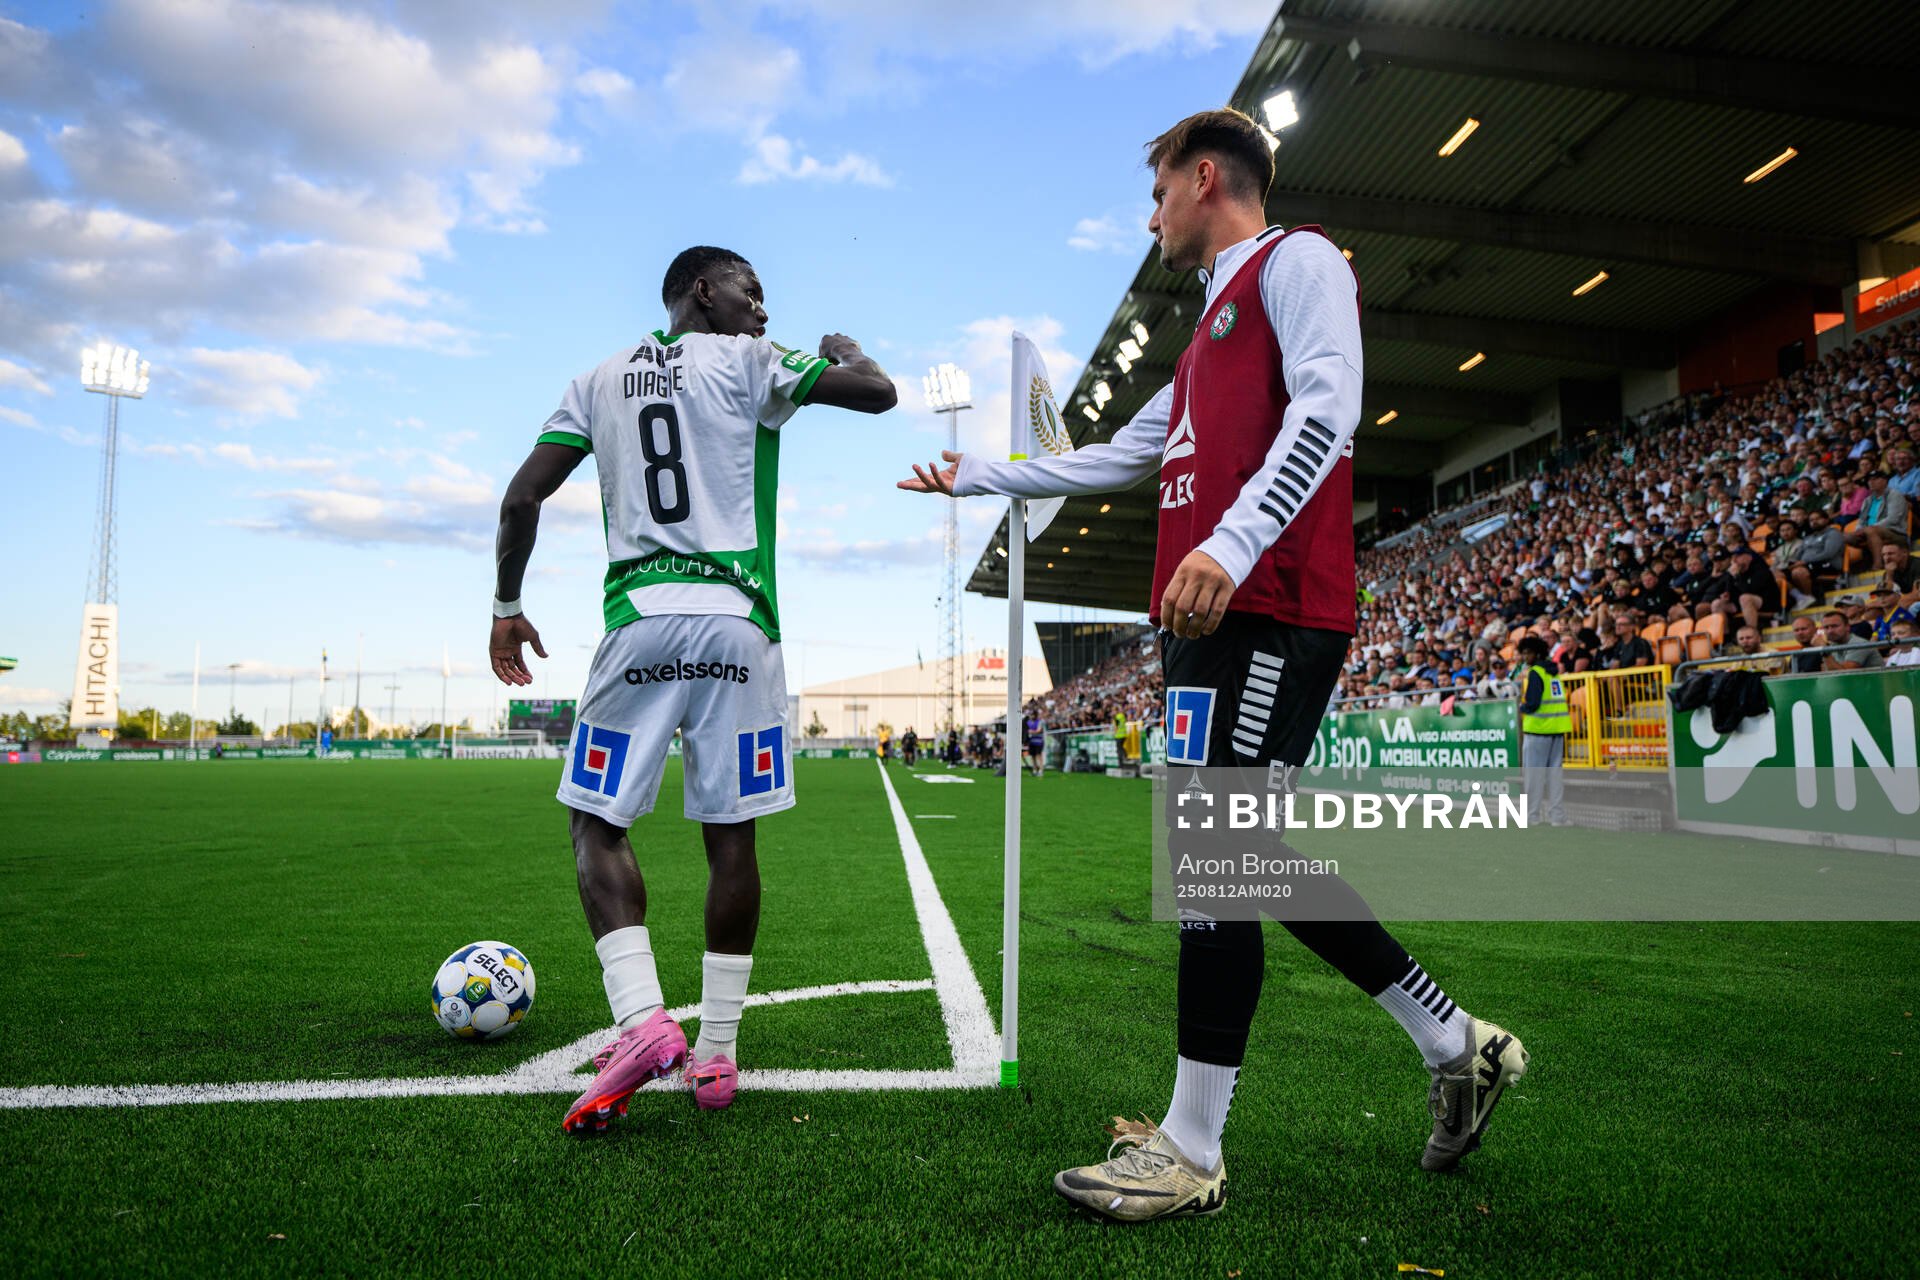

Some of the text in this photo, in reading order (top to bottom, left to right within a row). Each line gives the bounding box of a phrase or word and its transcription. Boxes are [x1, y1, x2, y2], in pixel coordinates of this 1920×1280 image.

[1875, 280, 1920, 312] Swed
[638, 403, 690, 524] 8
[85, 617, 110, 715] HITACHI
[624, 658, 749, 685] axelssons
[1440, 729, 1506, 742] ANDERSSON
[1380, 748, 1508, 768] MOBILKRANAR
[473, 953, 519, 994] SELECT
